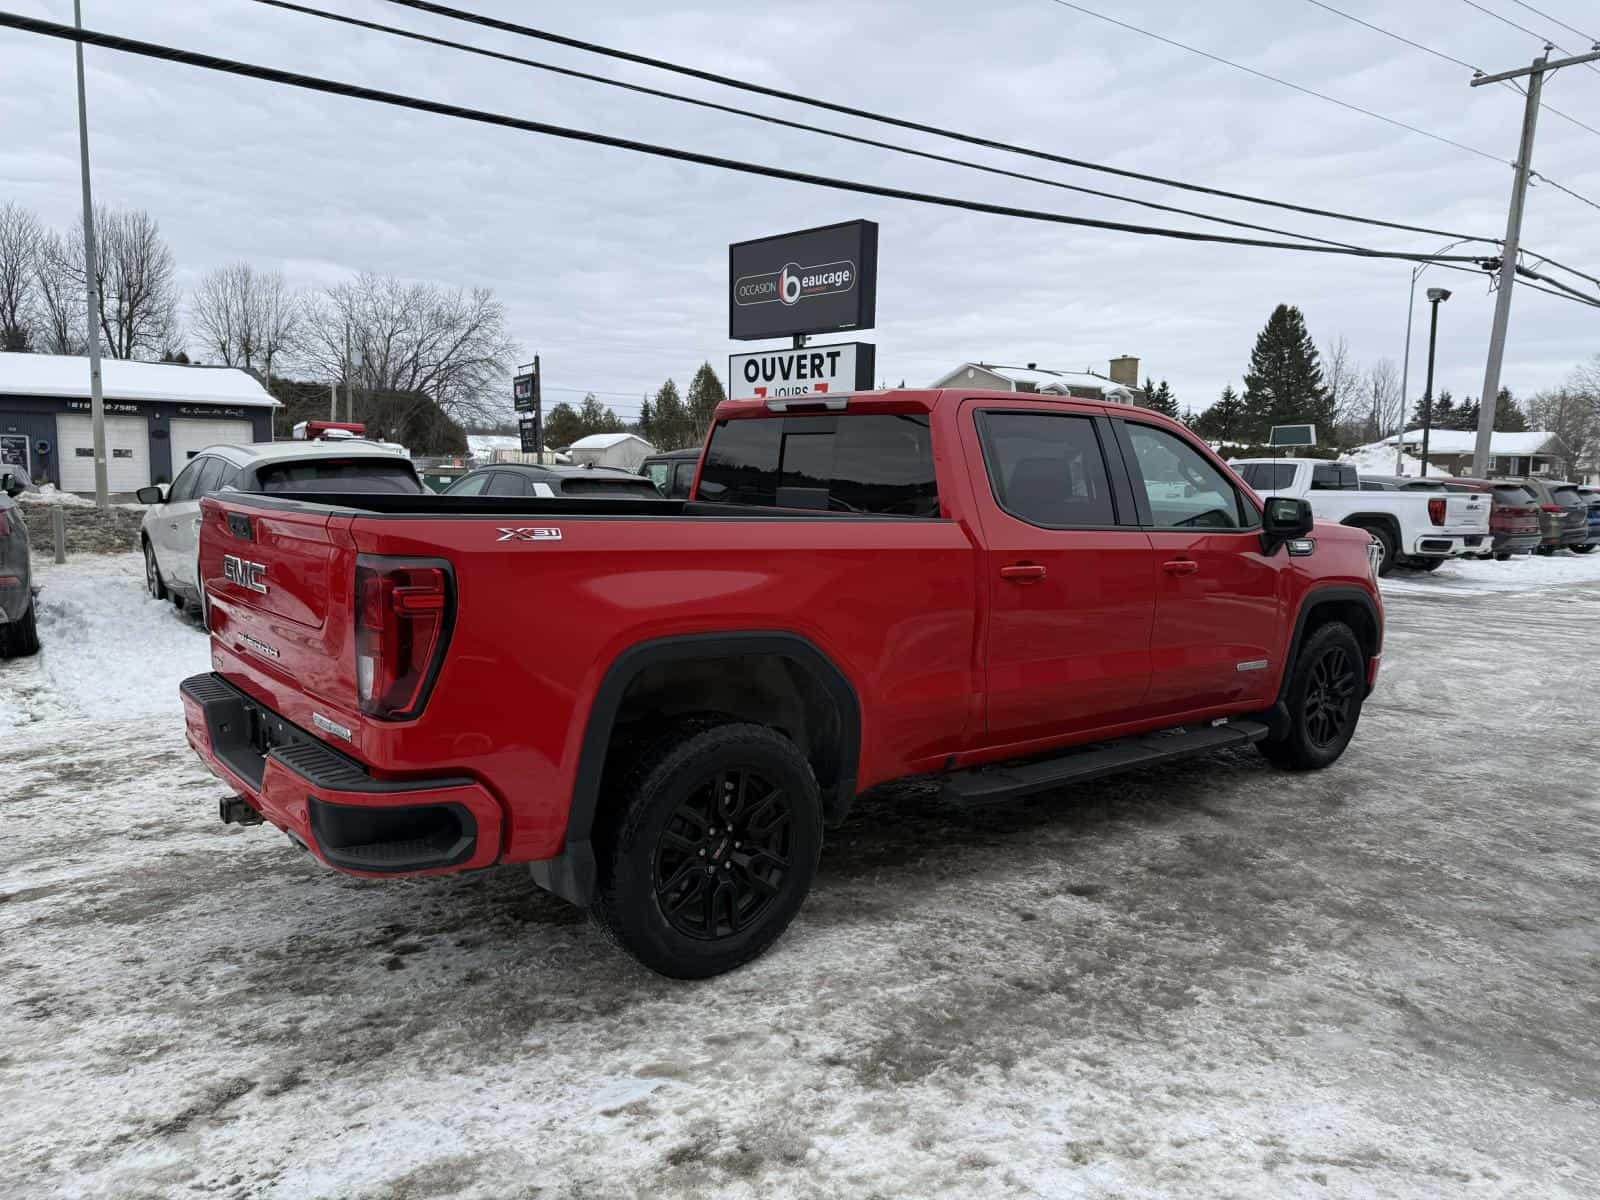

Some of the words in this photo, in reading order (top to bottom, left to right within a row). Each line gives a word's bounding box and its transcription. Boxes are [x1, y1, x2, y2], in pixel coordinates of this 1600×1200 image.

[740, 281, 777, 297] OCCASION
[744, 351, 840, 383] OUVERT
[224, 554, 268, 594] GMC
